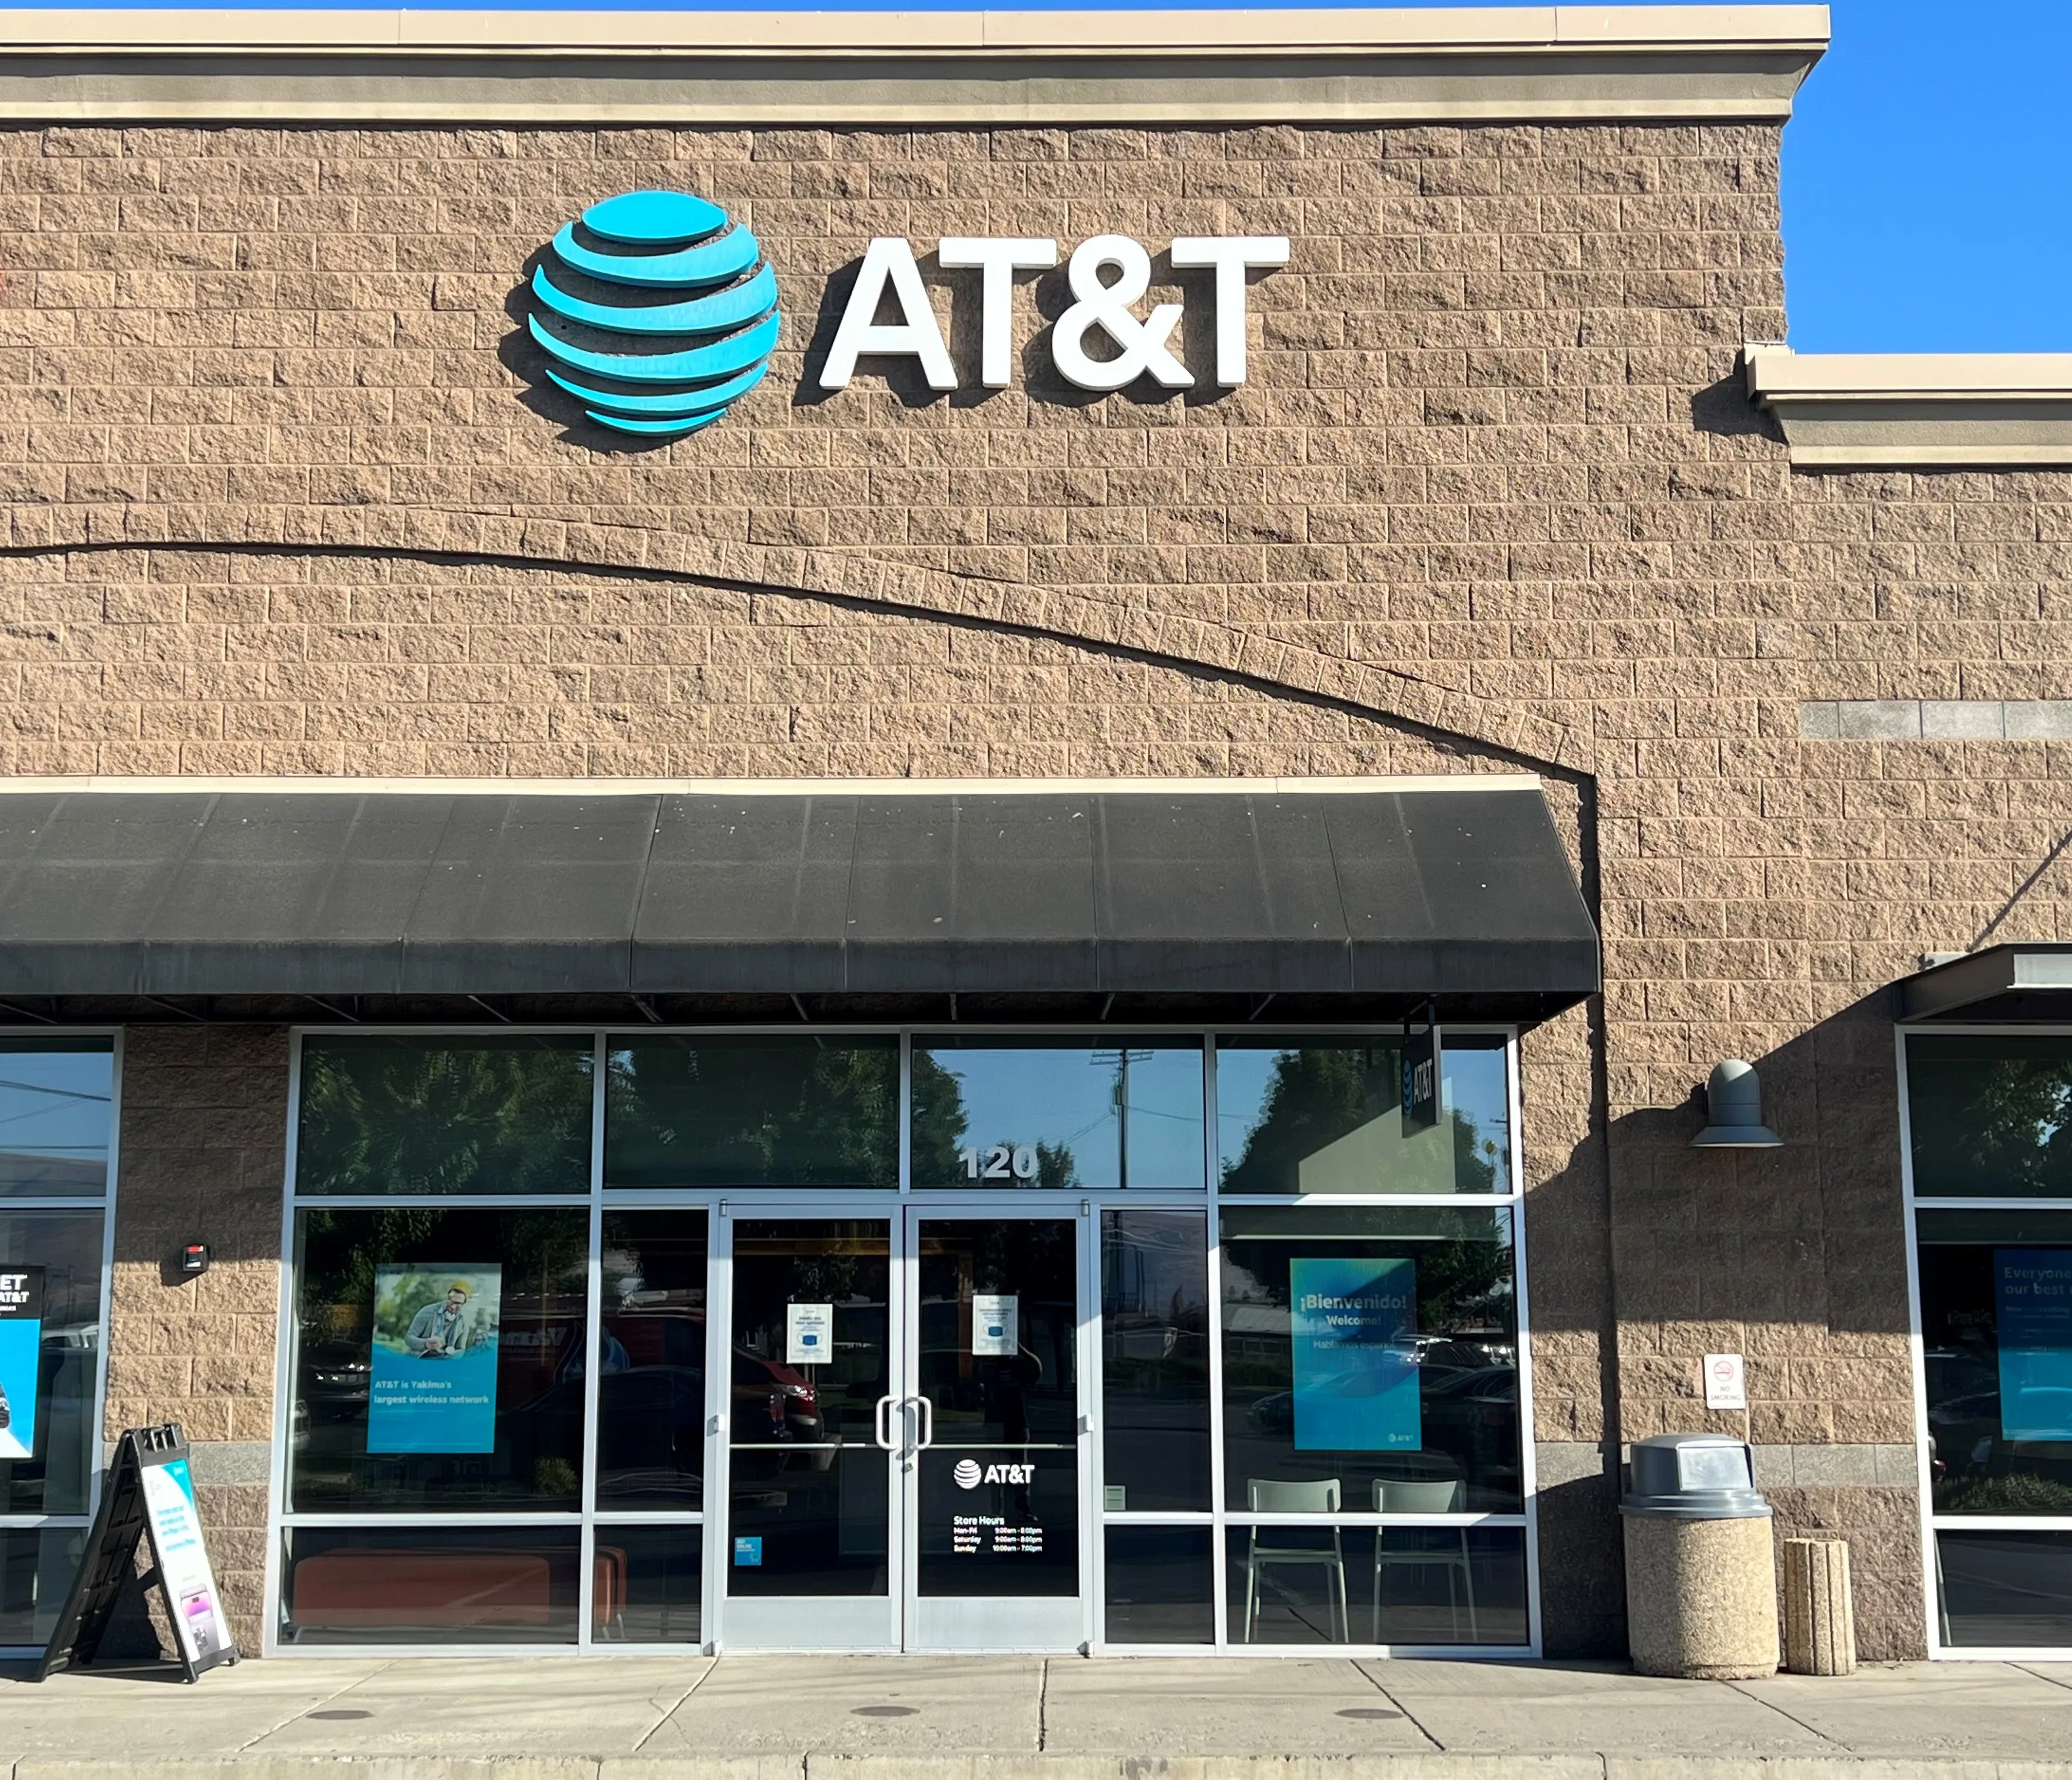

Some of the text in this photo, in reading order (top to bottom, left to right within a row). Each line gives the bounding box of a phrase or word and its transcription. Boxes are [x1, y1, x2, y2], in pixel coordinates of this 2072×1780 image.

[819, 234, 1290, 391] AT&T
[1414, 1058, 1432, 1105] AT&T
[957, 1147, 1038, 1178] 120
[2005, 1285, 2030, 1294] our
[2033, 1282, 2064, 1295] best
[1300, 1293, 1408, 1312] ¡Bienvenido!
[1326, 1315, 1381, 1325] Welcome!
[375, 1380, 452, 1389] AT&T is Yakima's
[374, 1395, 489, 1406] largest wireless network
[984, 1464, 1035, 1484] AT&T
[954, 1516, 1005, 1525] Store Hours
[954, 1536, 982, 1544] Saturday
[954, 1544, 977, 1553] Sunday
